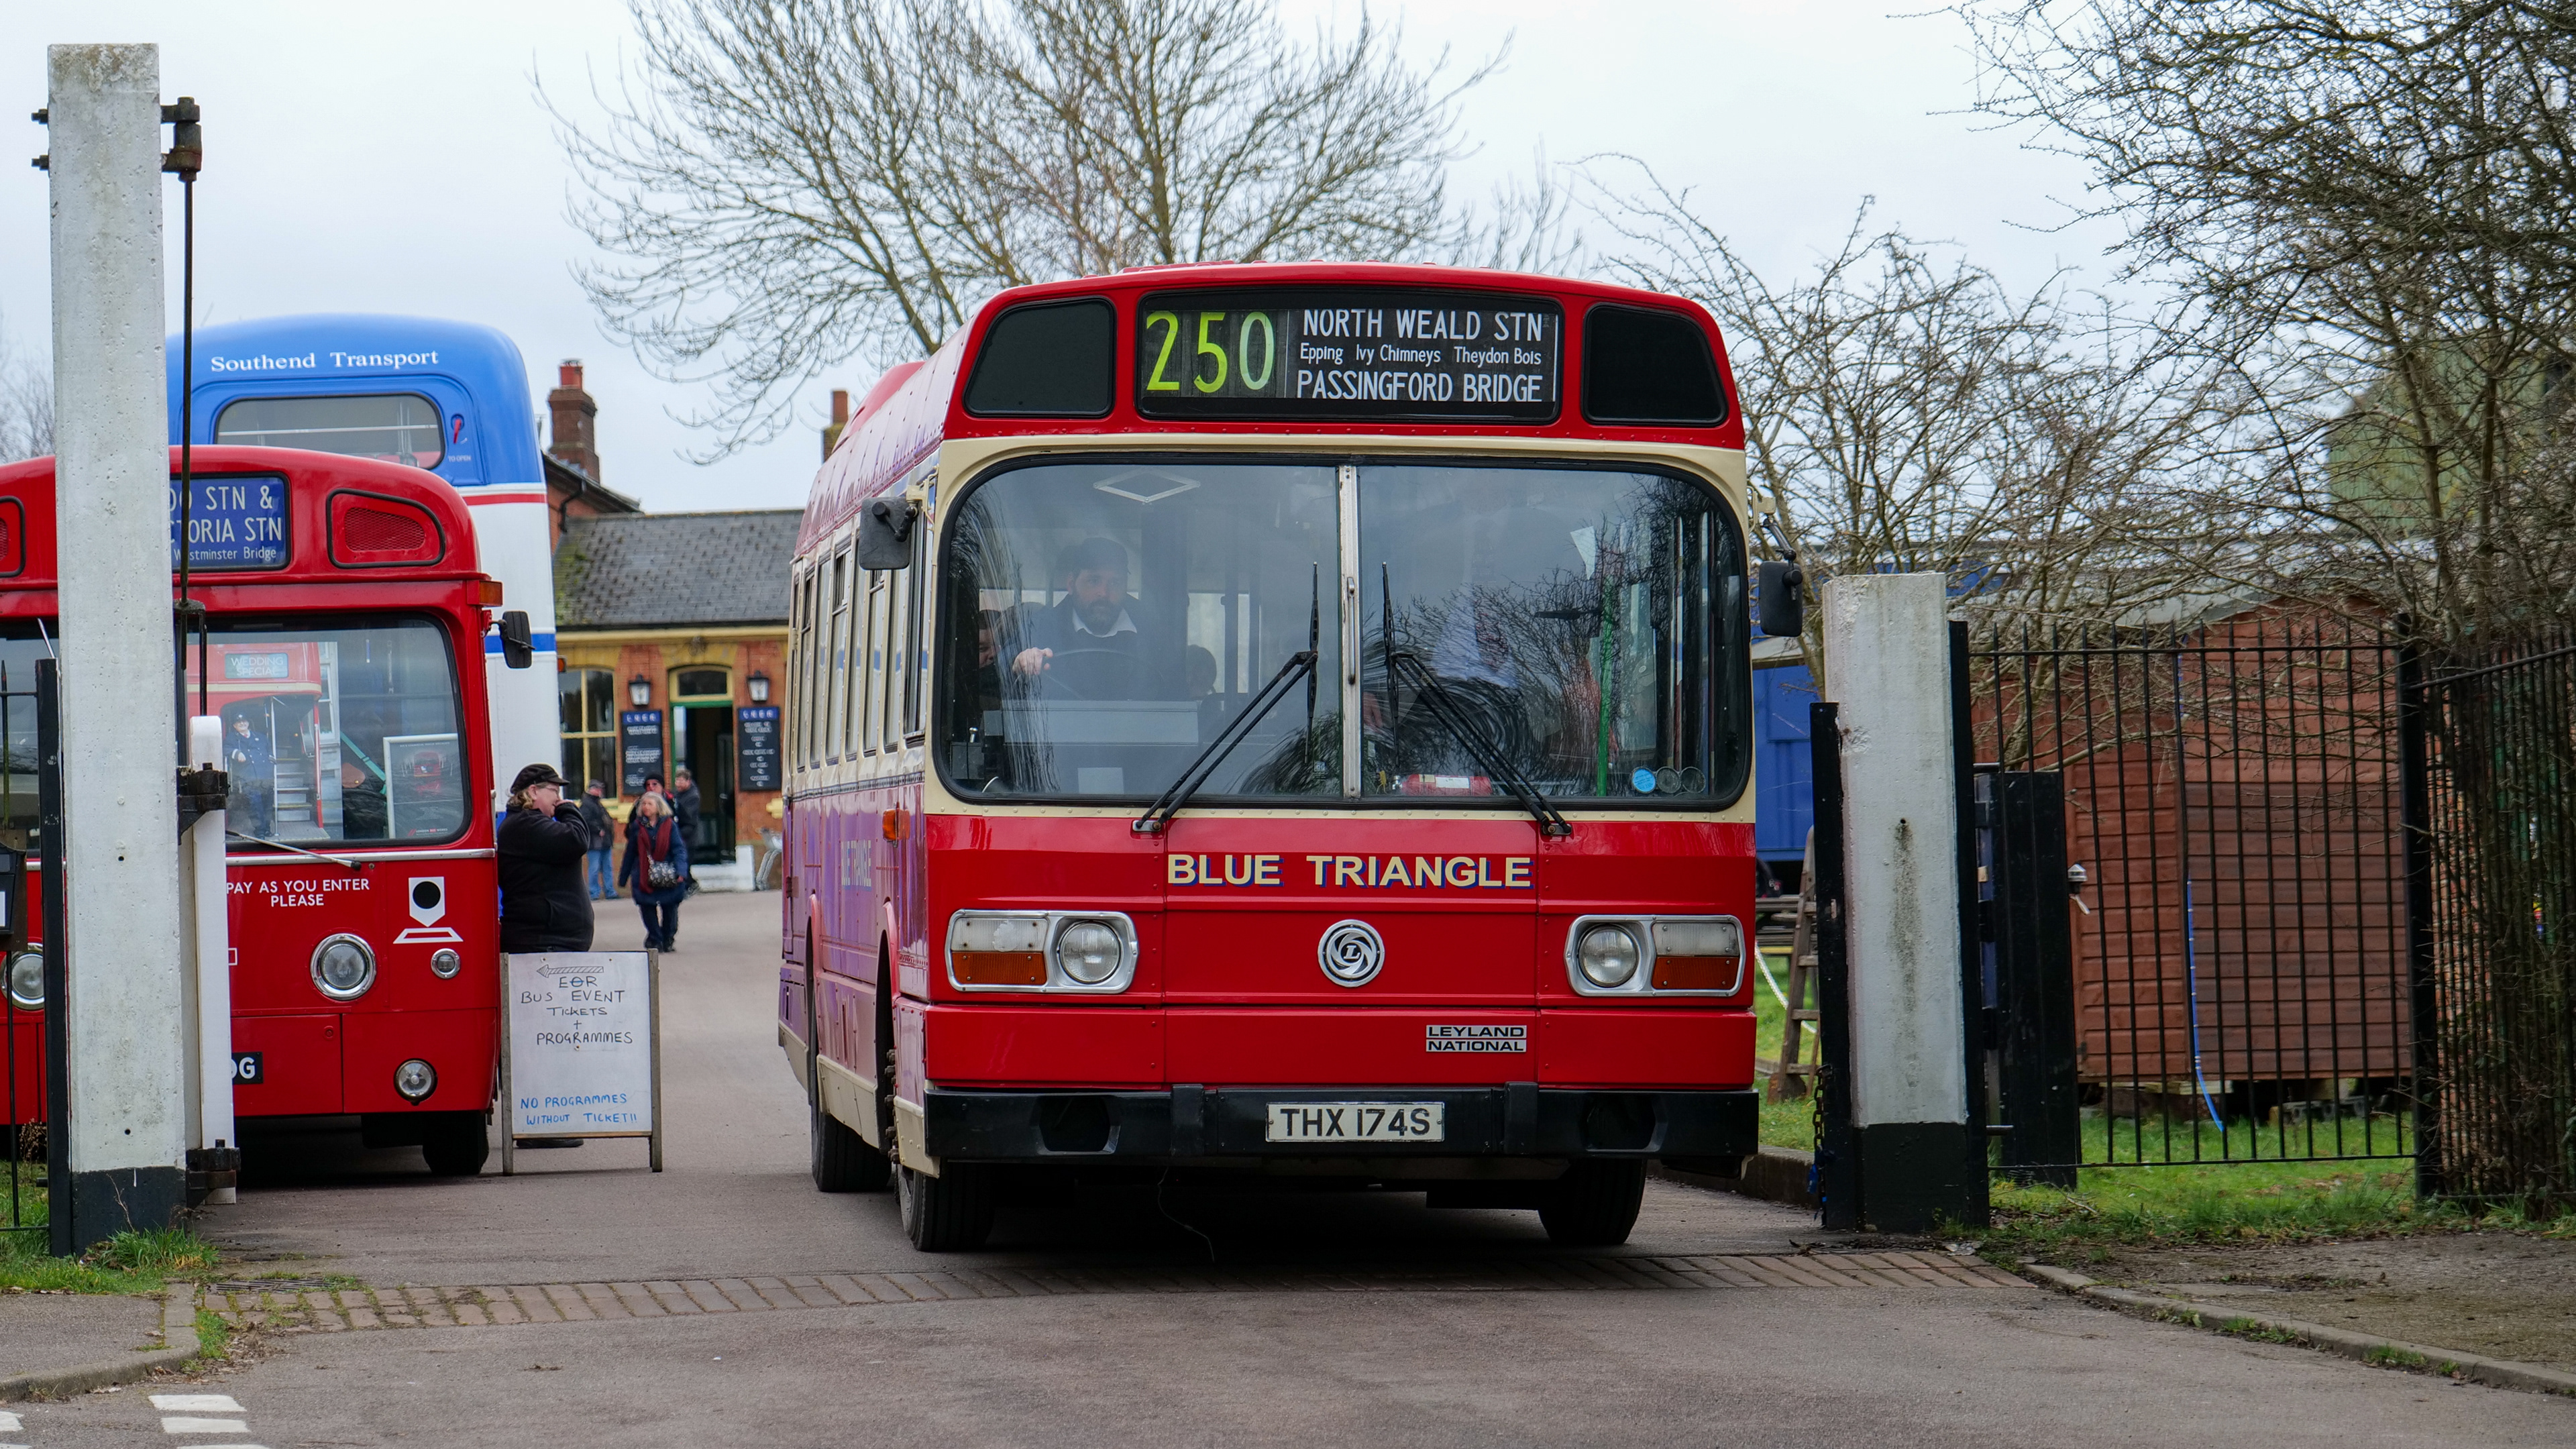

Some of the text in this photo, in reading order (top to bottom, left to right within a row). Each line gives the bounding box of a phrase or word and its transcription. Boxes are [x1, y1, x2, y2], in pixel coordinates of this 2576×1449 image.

[1303, 309, 1383, 337] NORTH
[1396, 309, 1481, 339] WEALD
[1494, 312, 1542, 341] STN
[1146, 311, 1275, 393] 250
[1300, 342, 1542, 368] Epping Ivy Chimneys Theydon Bois
[211, 350, 439, 372] Southend Transport
[1297, 370, 1543, 402] PASSINGFORD BRIDGE
[206, 486, 246, 511] STN
[260, 484, 273, 509] &
[244, 517, 282, 542] STN
[173, 545, 276, 562] Wstminster Bridge
[230, 657, 284, 667] WEDDING
[236, 666, 279, 677] SPECIAL
[1168, 854, 1534, 889] BLUE TRIANGLE
[227, 878, 370, 894] PAY AS YOU ENTER
[270, 894, 325, 908] PLEASE
[521, 989, 625, 1004] BUS EVENT
[536, 1031, 633, 1046] PROGRAMMES
[1429, 1026, 1524, 1037] LEYLAND
[1428, 1040, 1524, 1051] NATIONAL
[521, 1093, 627, 1109] NO PROGRAMMES
[527, 1112, 637, 1126] WITHOUT TICKET!!
[1280, 1108, 1430, 1136] THX 174S
